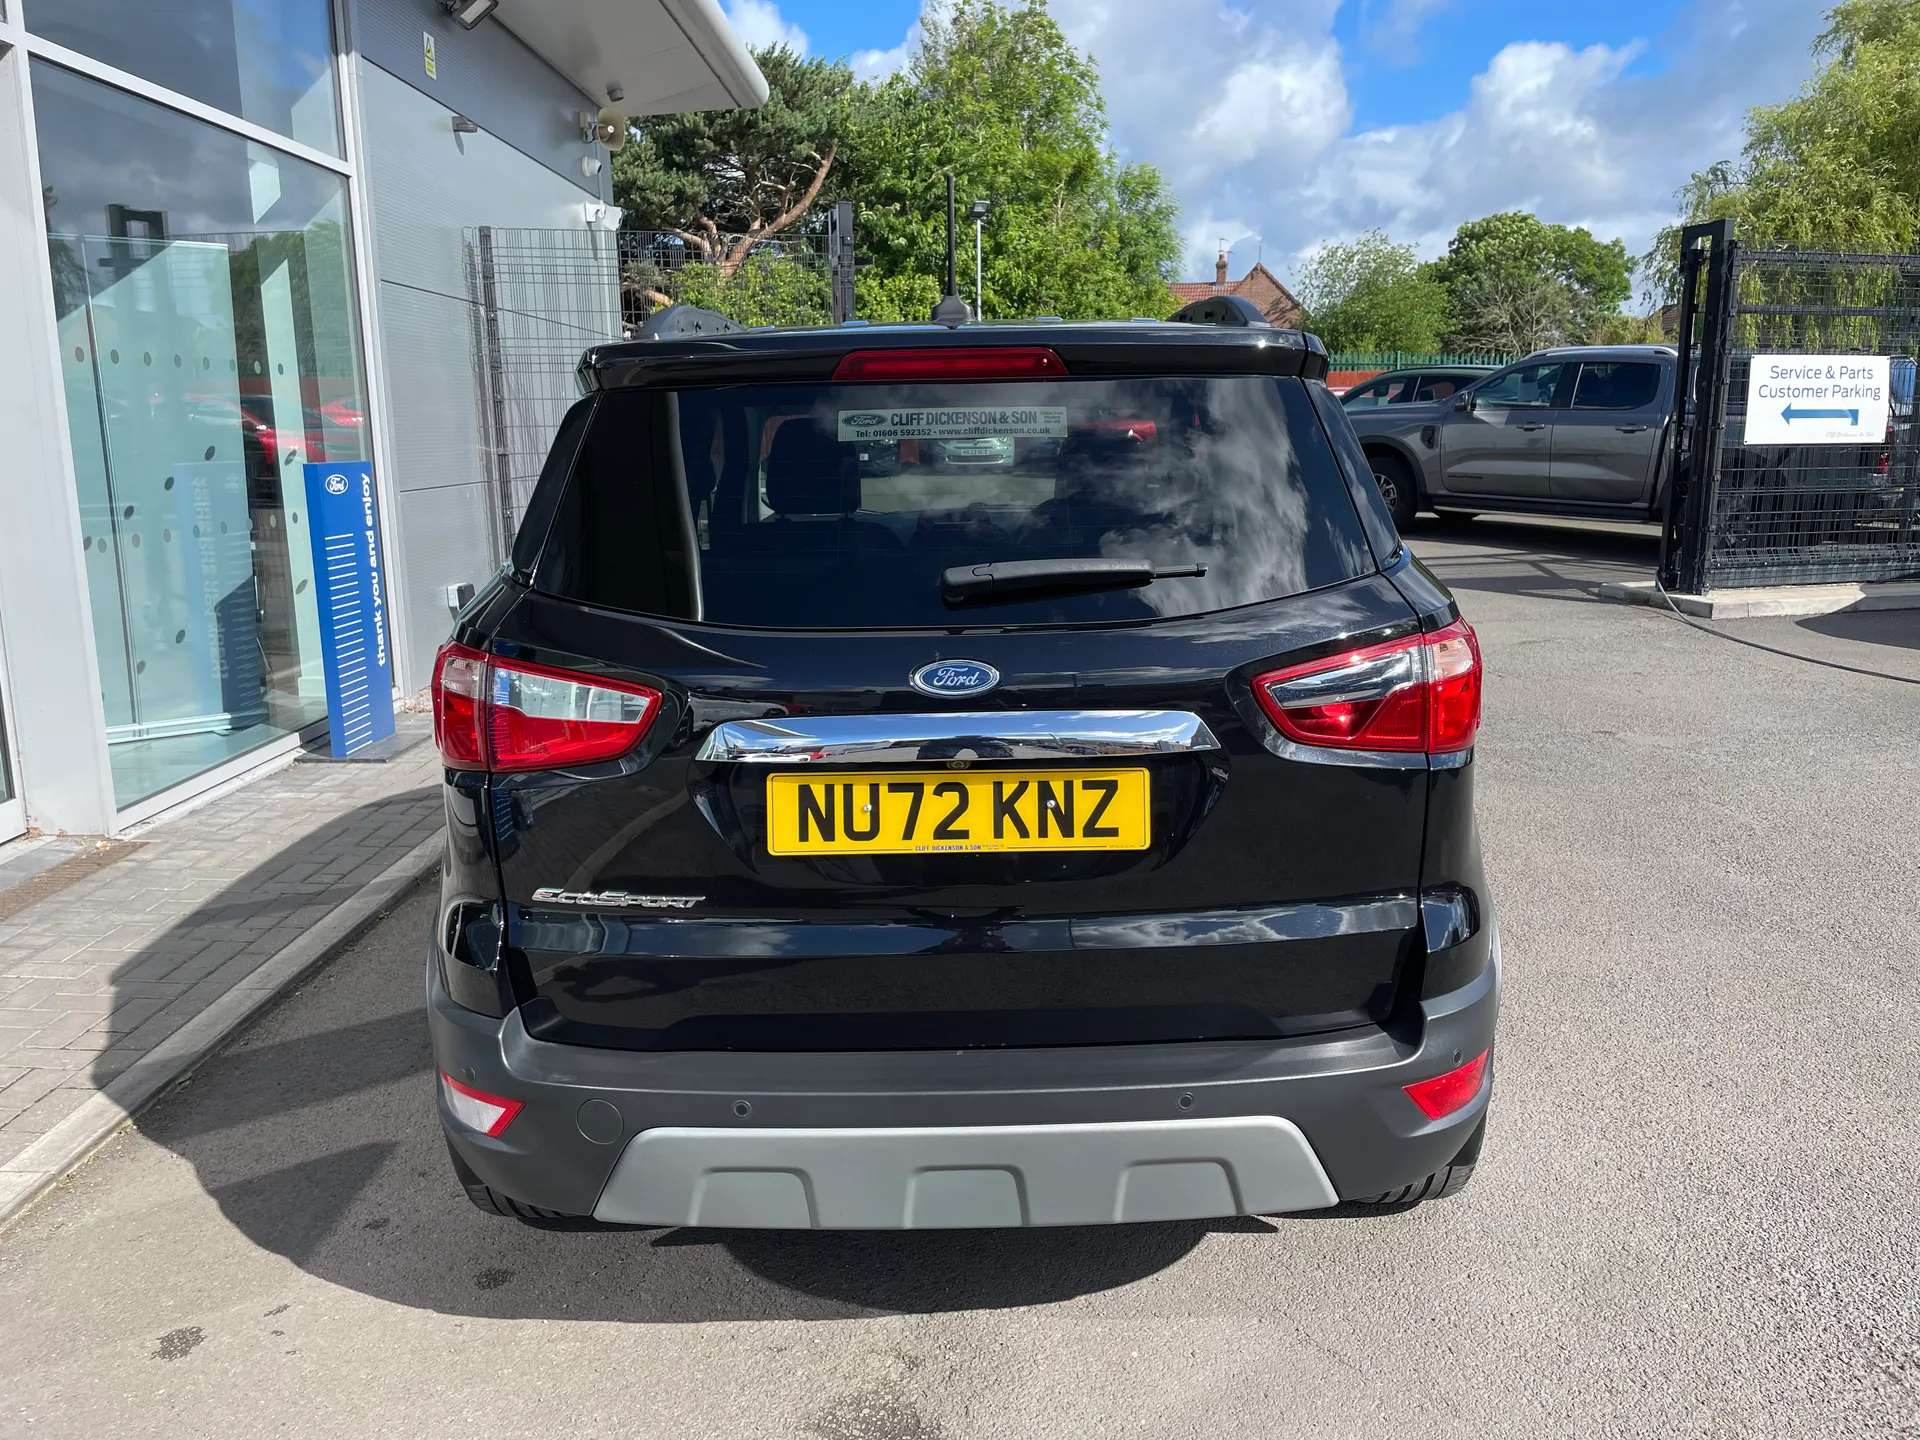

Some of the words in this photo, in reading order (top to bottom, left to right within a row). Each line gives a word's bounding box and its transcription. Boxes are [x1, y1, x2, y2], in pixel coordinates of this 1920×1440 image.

[1770, 365, 1822, 380] Service
[1825, 365, 1836, 379] &
[1839, 366, 1874, 380] Parts
[1758, 384, 1828, 398] Customer
[1832, 384, 1881, 400] Parking
[855, 430, 872, 438] Tel:
[873, 429, 898, 437] 01606
[900, 428, 931, 437] 592352
[938, 426, 1051, 436] www.cliffdickenson.co.uk
[890, 412, 925, 426] CLIFF
[926, 411, 997, 426] DICKENSON
[999, 411, 1009, 425] &
[1011, 410, 1037, 425] SON
[360, 472, 373, 528] enjoy
[365, 529, 377, 568] and
[370, 571, 382, 608] you
[373, 609, 386, 667] thank
[932, 667, 981, 687] Ford
[797, 781, 971, 843] NU72
[992, 779, 1120, 840] KNZ
